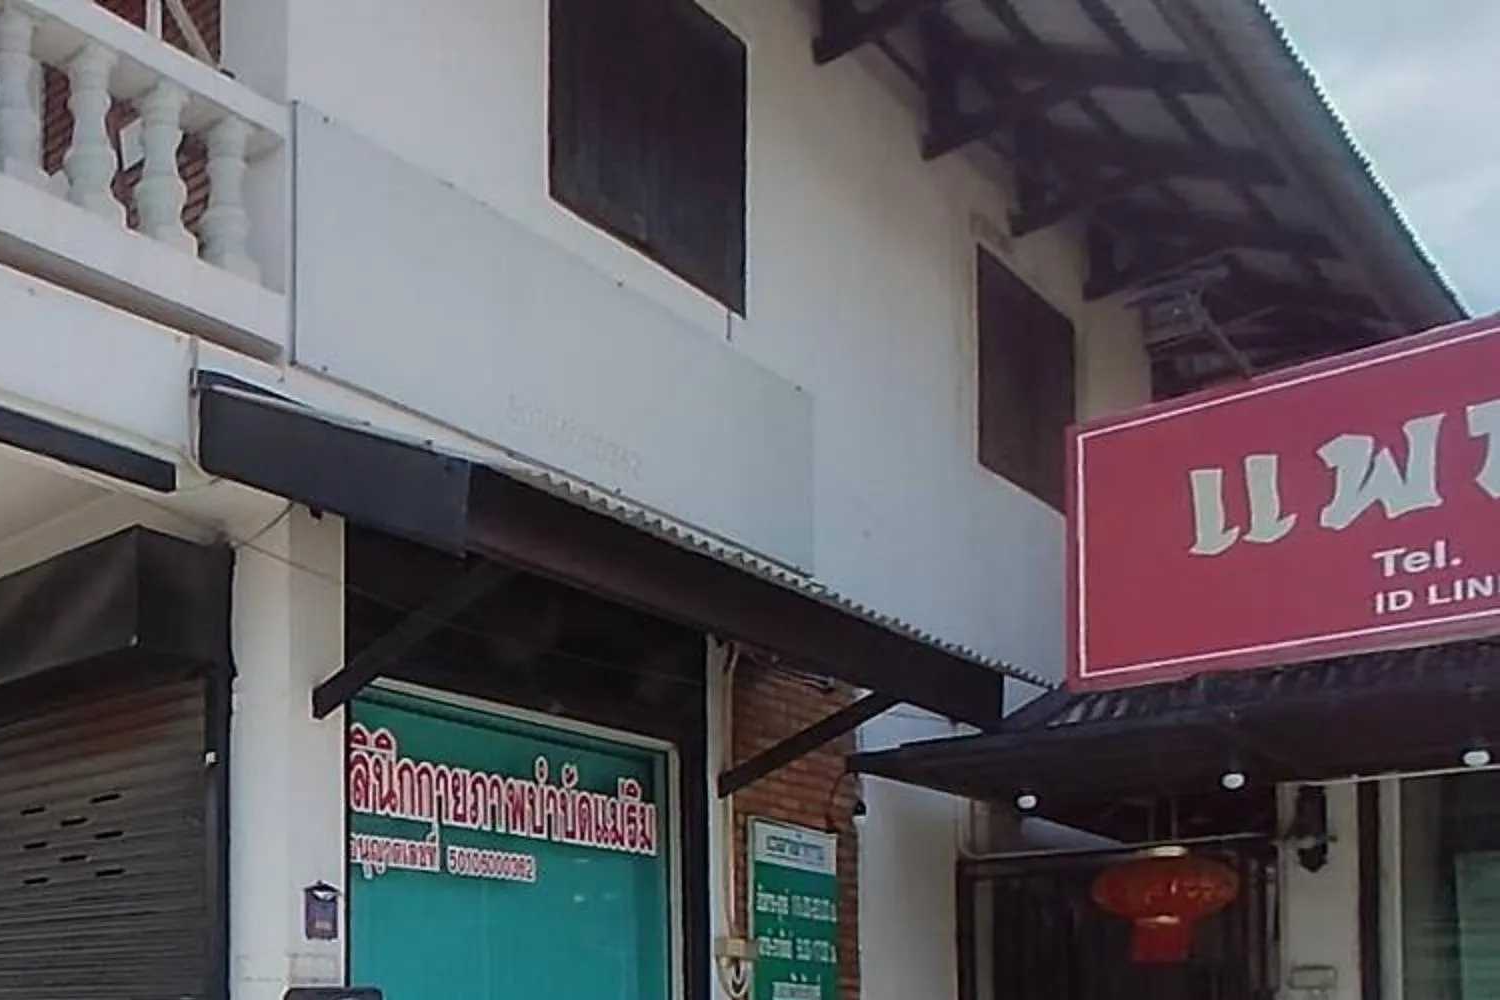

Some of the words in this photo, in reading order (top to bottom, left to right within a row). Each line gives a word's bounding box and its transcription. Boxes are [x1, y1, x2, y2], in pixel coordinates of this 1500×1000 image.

[1371, 540, 1462, 577] Tel.
[1375, 588, 1414, 615] ID
[1426, 574, 1500, 606] LIN
[349, 722, 657, 855] ลินิกกายภาพบำบัดแม่ริม
